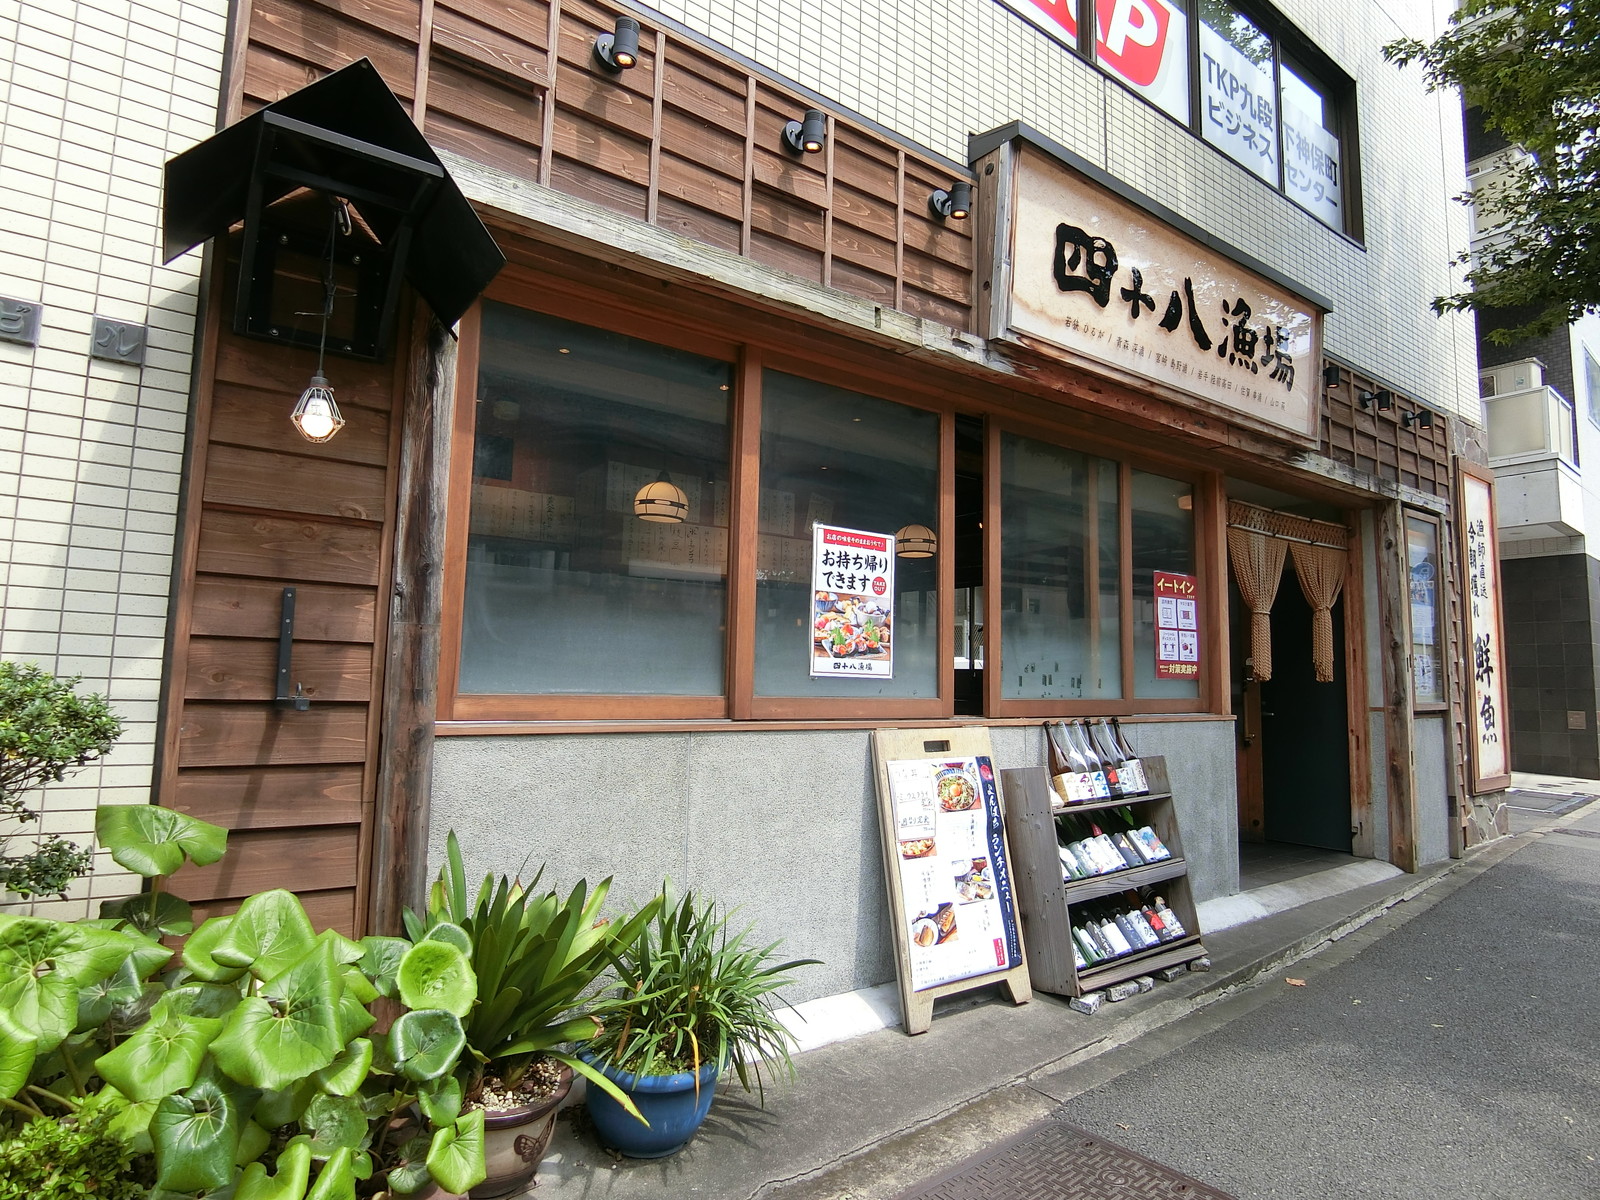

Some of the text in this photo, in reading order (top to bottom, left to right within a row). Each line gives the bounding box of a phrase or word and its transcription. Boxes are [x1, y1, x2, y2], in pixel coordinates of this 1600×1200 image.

[1208, 95, 1274, 164] ビジネス
[1053, 222, 1296, 393] 四十八漁場
[821, 549, 888, 574] お持ち帰り
[822, 571, 870, 592] できます
[1157, 577, 1194, 594] イートイン
